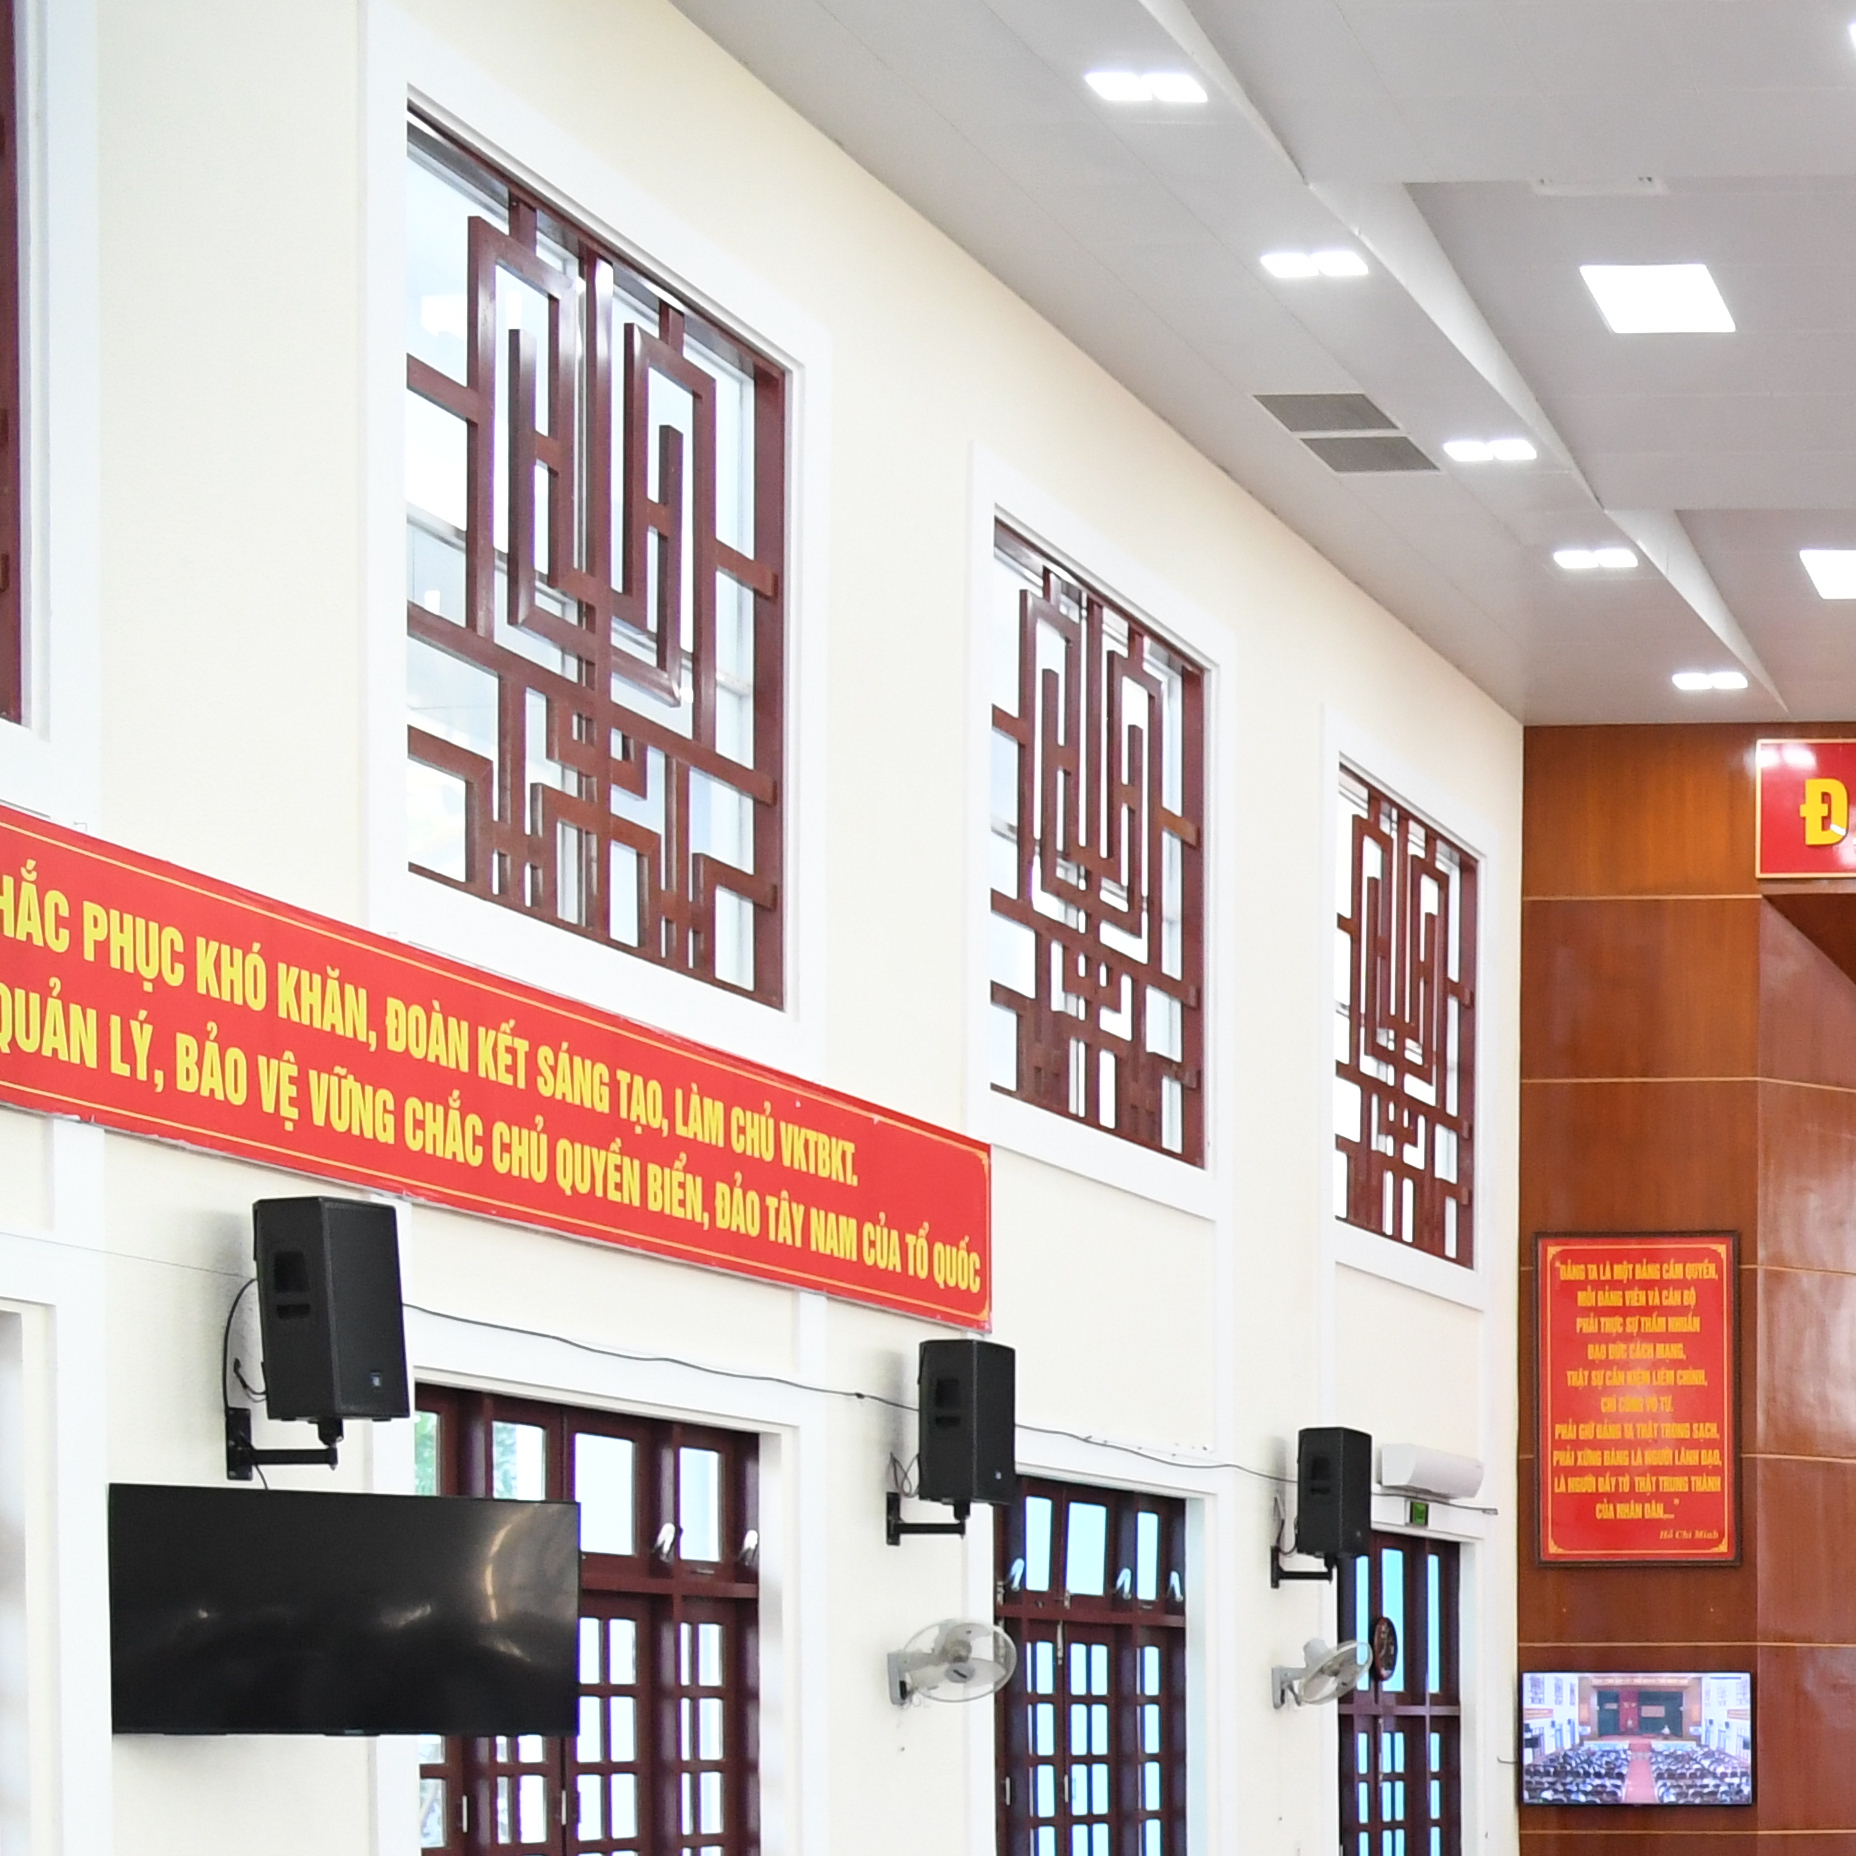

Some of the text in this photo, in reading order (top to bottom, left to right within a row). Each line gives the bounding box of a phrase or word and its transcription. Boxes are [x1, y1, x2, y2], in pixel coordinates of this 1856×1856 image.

[83, 901, 184, 992] PHỤC
[197, 937, 266, 1011] KHÓ
[278, 962, 376, 1051] KHĂN,
[386, 997, 469, 1072] ĐOÀN
[478, 1020, 529, 1089] KẾT
[537, 1042, 609, 1113] SÁNG
[617, 1070, 668, 1136] TẠO,
[676, 1083, 724, 1147] LÀM
[731, 1101, 774, 1161] CHỦ
[780, 1121, 859, 1186] VKTBKT.
[110, 1010, 163, 1092] LÝ,
[176, 1022, 247, 1105] BẢO
[258, 1051, 298, 1131] VỆ
[309, 1070, 394, 1144] VỮNG
[405, 1090, 483, 1166] CHẮC
[493, 1115, 547, 1182] CHỦ
[556, 1138, 640, 1206] QUYỀN
[648, 1152, 709, 1230] BIỂN,
[715, 1172, 760, 1236] ĐẢO
[766, 1191, 804, 1247] TÂY
[810, 1208, 857, 1261] NAM
[863, 1212, 901, 1272] CỦA
[906, 1222, 929, 1278] TỔ
[933, 1237, 980, 1293] QUỐC
